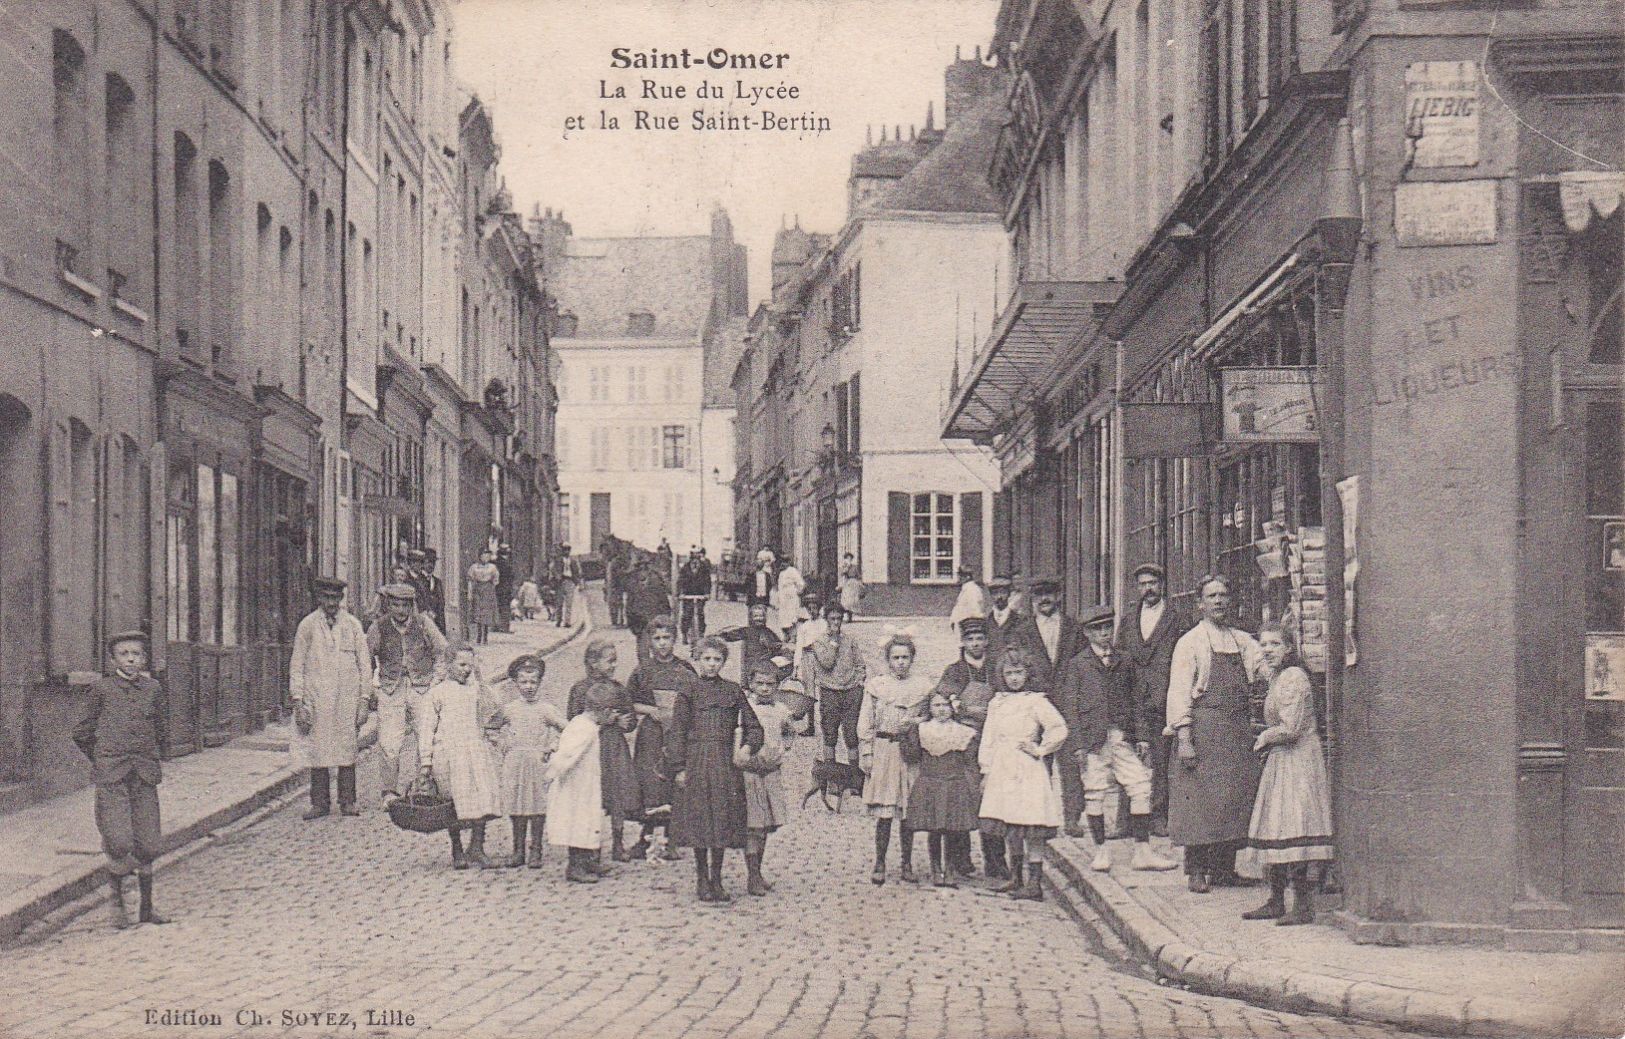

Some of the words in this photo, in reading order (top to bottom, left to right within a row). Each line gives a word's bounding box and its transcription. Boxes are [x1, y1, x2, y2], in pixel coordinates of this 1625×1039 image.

[1408, 97, 1476, 119] LIEBIG
[1406, 264, 1475, 300] VINS
[1423, 313, 1461, 345] ET
